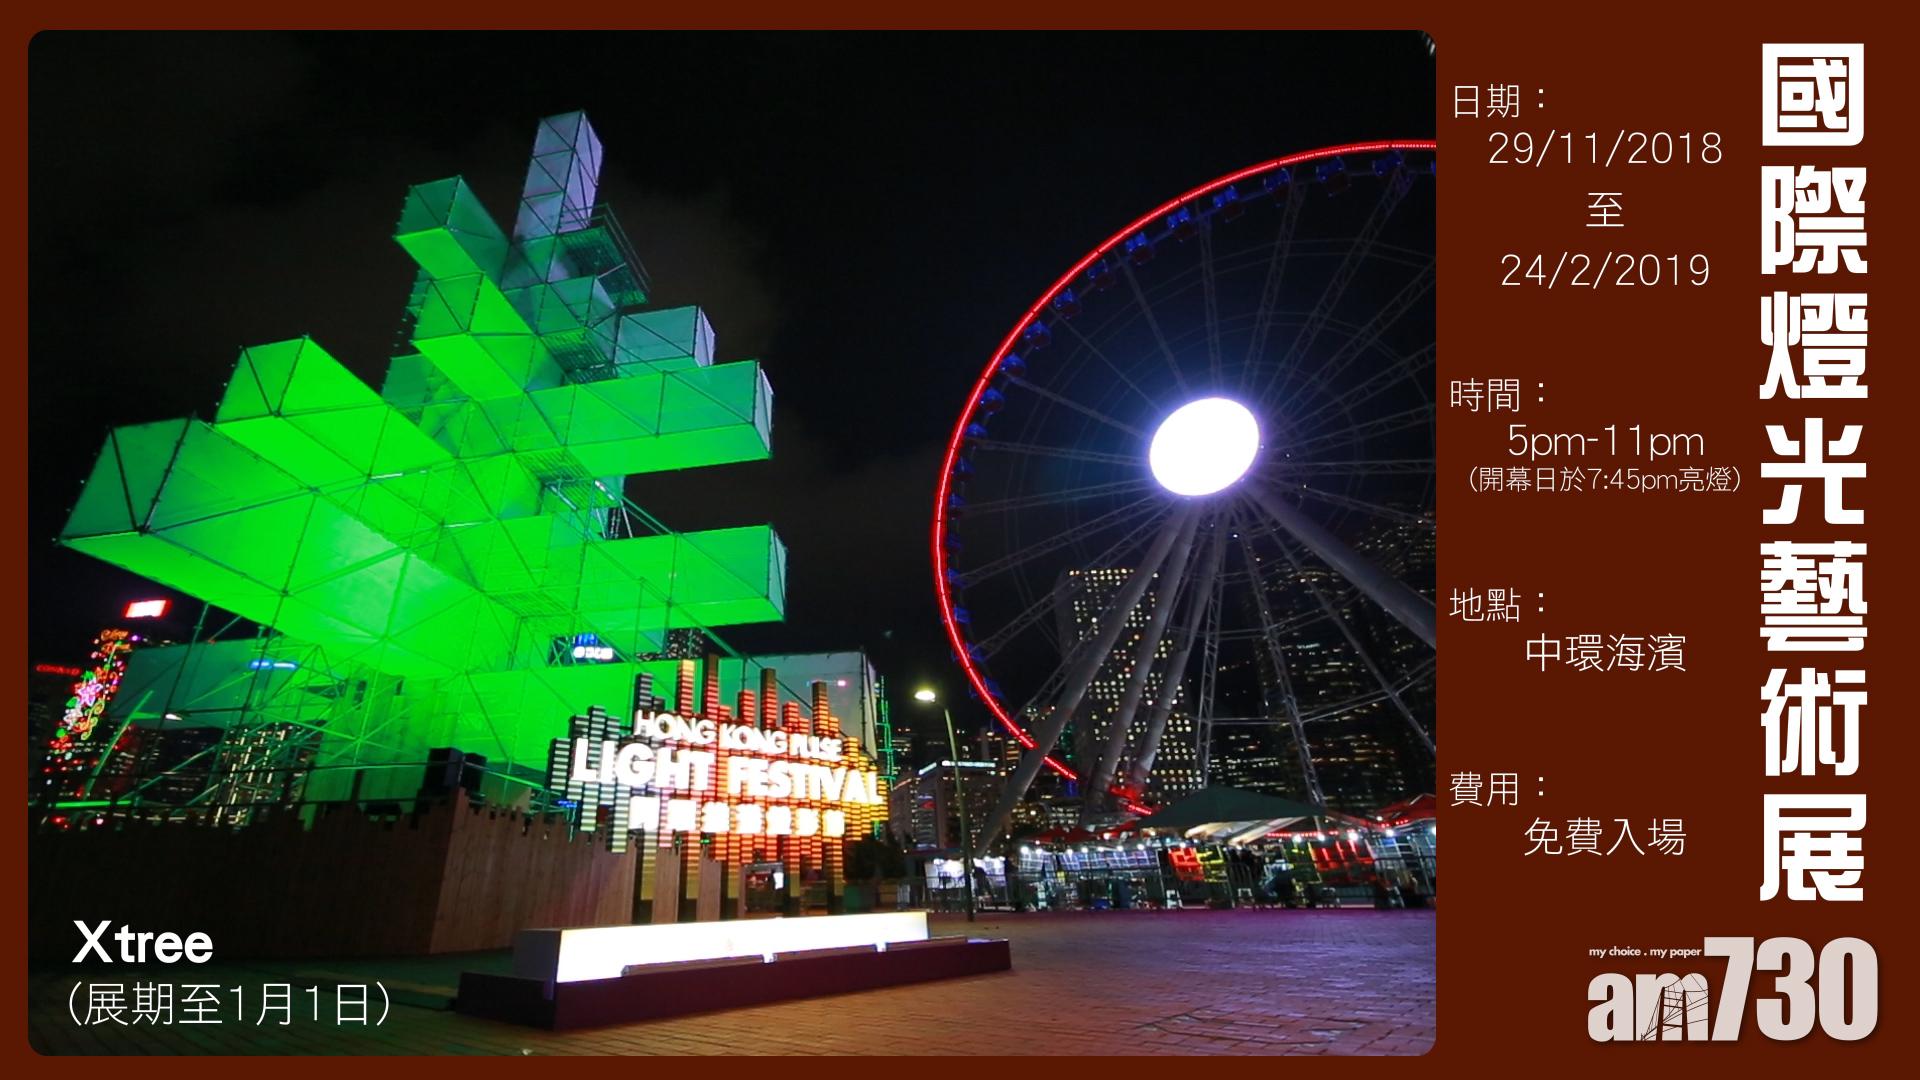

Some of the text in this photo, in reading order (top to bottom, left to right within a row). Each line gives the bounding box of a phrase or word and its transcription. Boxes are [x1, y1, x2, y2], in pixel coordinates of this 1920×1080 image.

[634, 710, 842, 762] HONG KONG PULSE
[571, 737, 884, 805] LIGHT FESTIVAL
